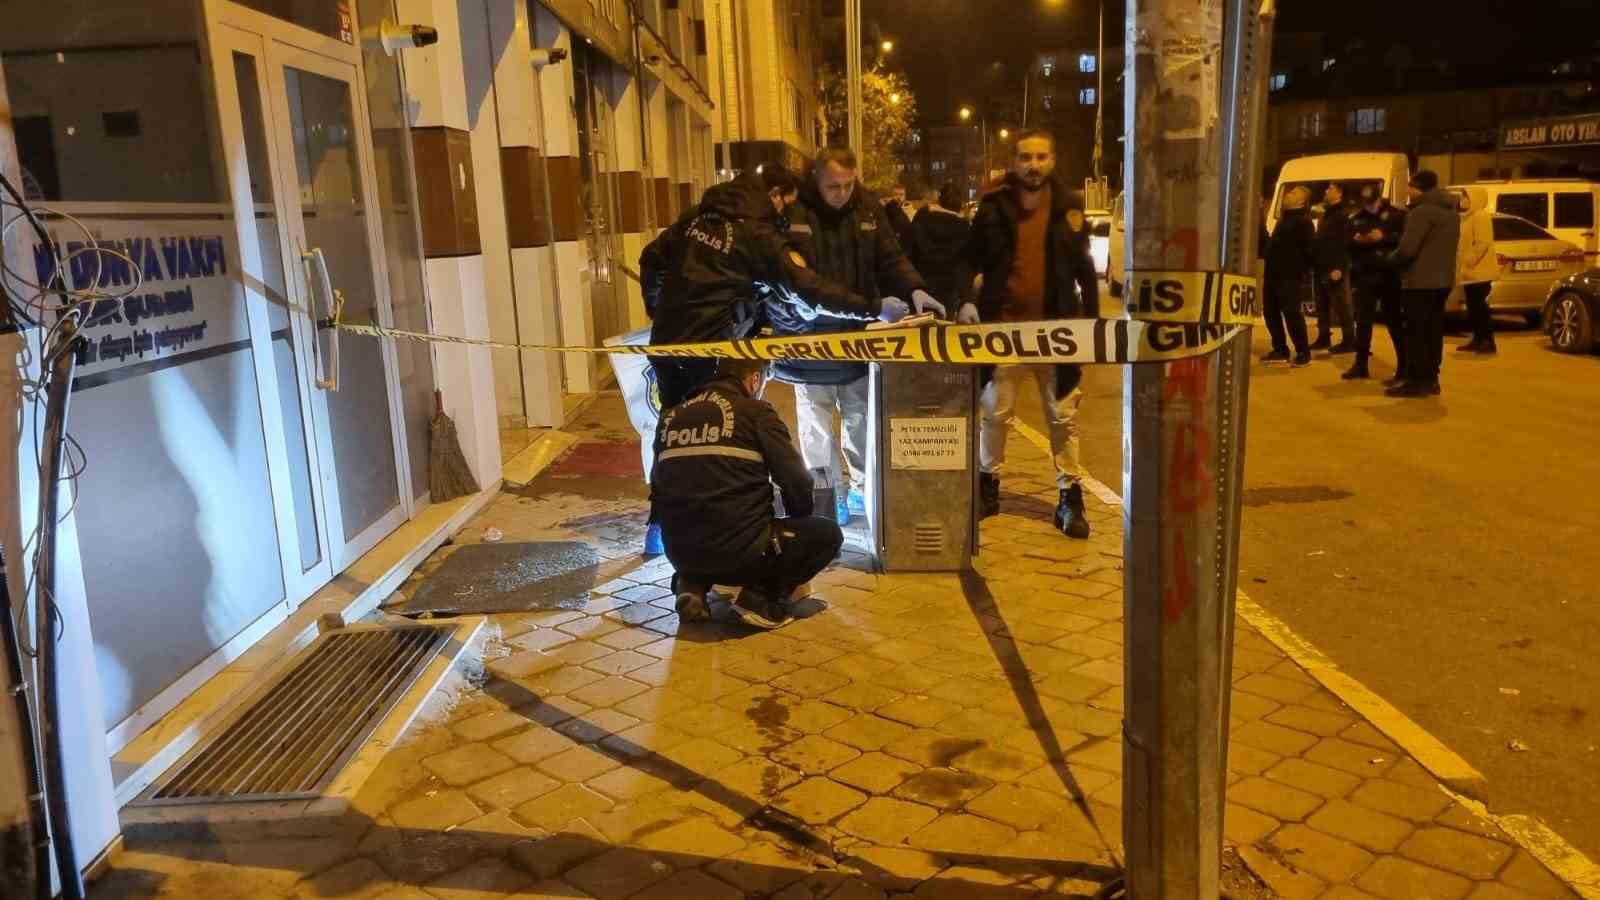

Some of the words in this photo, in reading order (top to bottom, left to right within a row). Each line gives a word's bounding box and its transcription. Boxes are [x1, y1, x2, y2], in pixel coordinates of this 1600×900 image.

[1505, 126, 1546, 146] ARSLAN
[1551, 123, 1574, 141] OTO
[766, 336, 914, 361] GİRİLMEZ
[959, 327, 1079, 359] POLİS
[666, 423, 721, 447] POLİS
